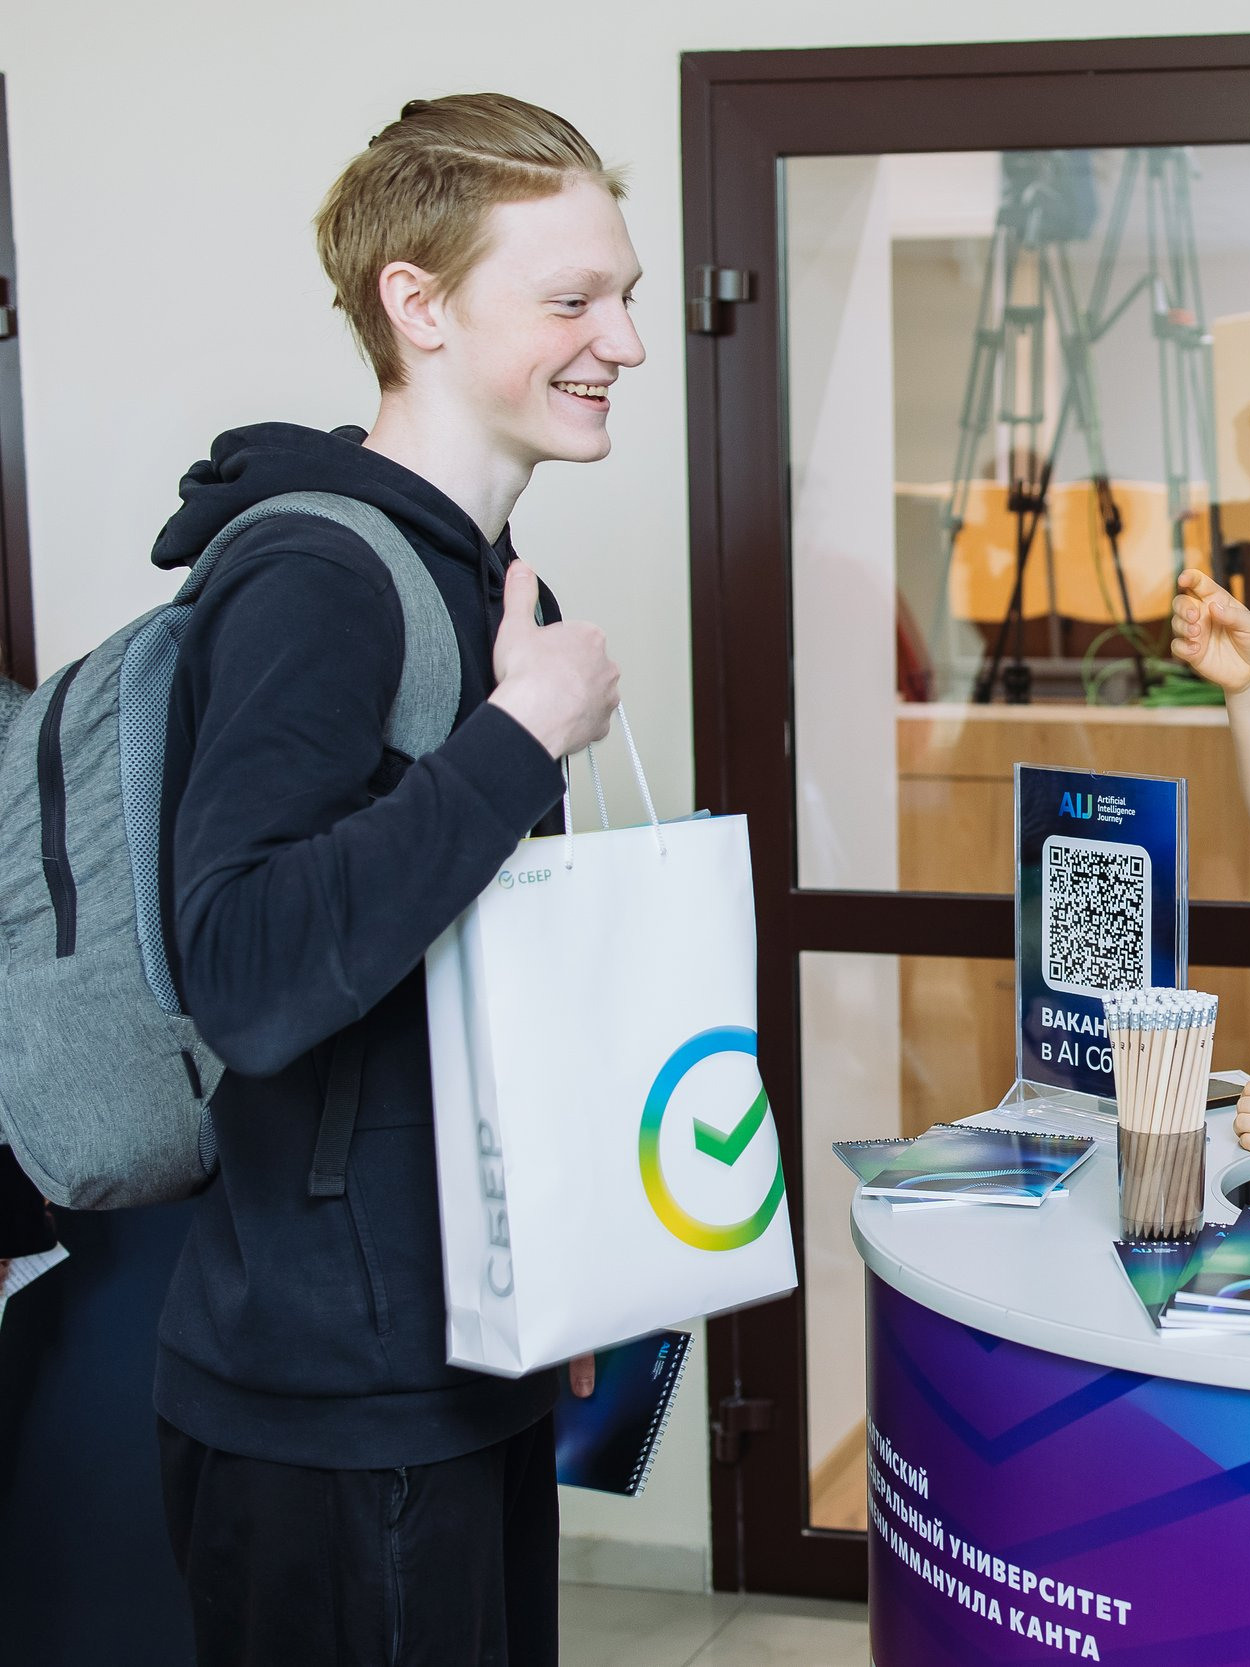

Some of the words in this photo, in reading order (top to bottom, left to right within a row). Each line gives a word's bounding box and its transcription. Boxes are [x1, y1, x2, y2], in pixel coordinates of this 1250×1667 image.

[1059, 791, 1093, 819] AIJ
[1097, 795, 1126, 806] Artificial
[1097, 804, 1136, 816] Intelligence
[1097, 813, 1123, 825] Journey
[518, 869, 552, 884] СБЕР
[1041, 1006, 1108, 1038] ВАКАН
[1057, 1040, 1079, 1067] AI
[949, 1534, 1132, 1626] УНИВЕРСИТЕТ
[890, 1527, 1003, 1625] ИММАНУИЛА
[1009, 1607, 1100, 1662] КАНТА
